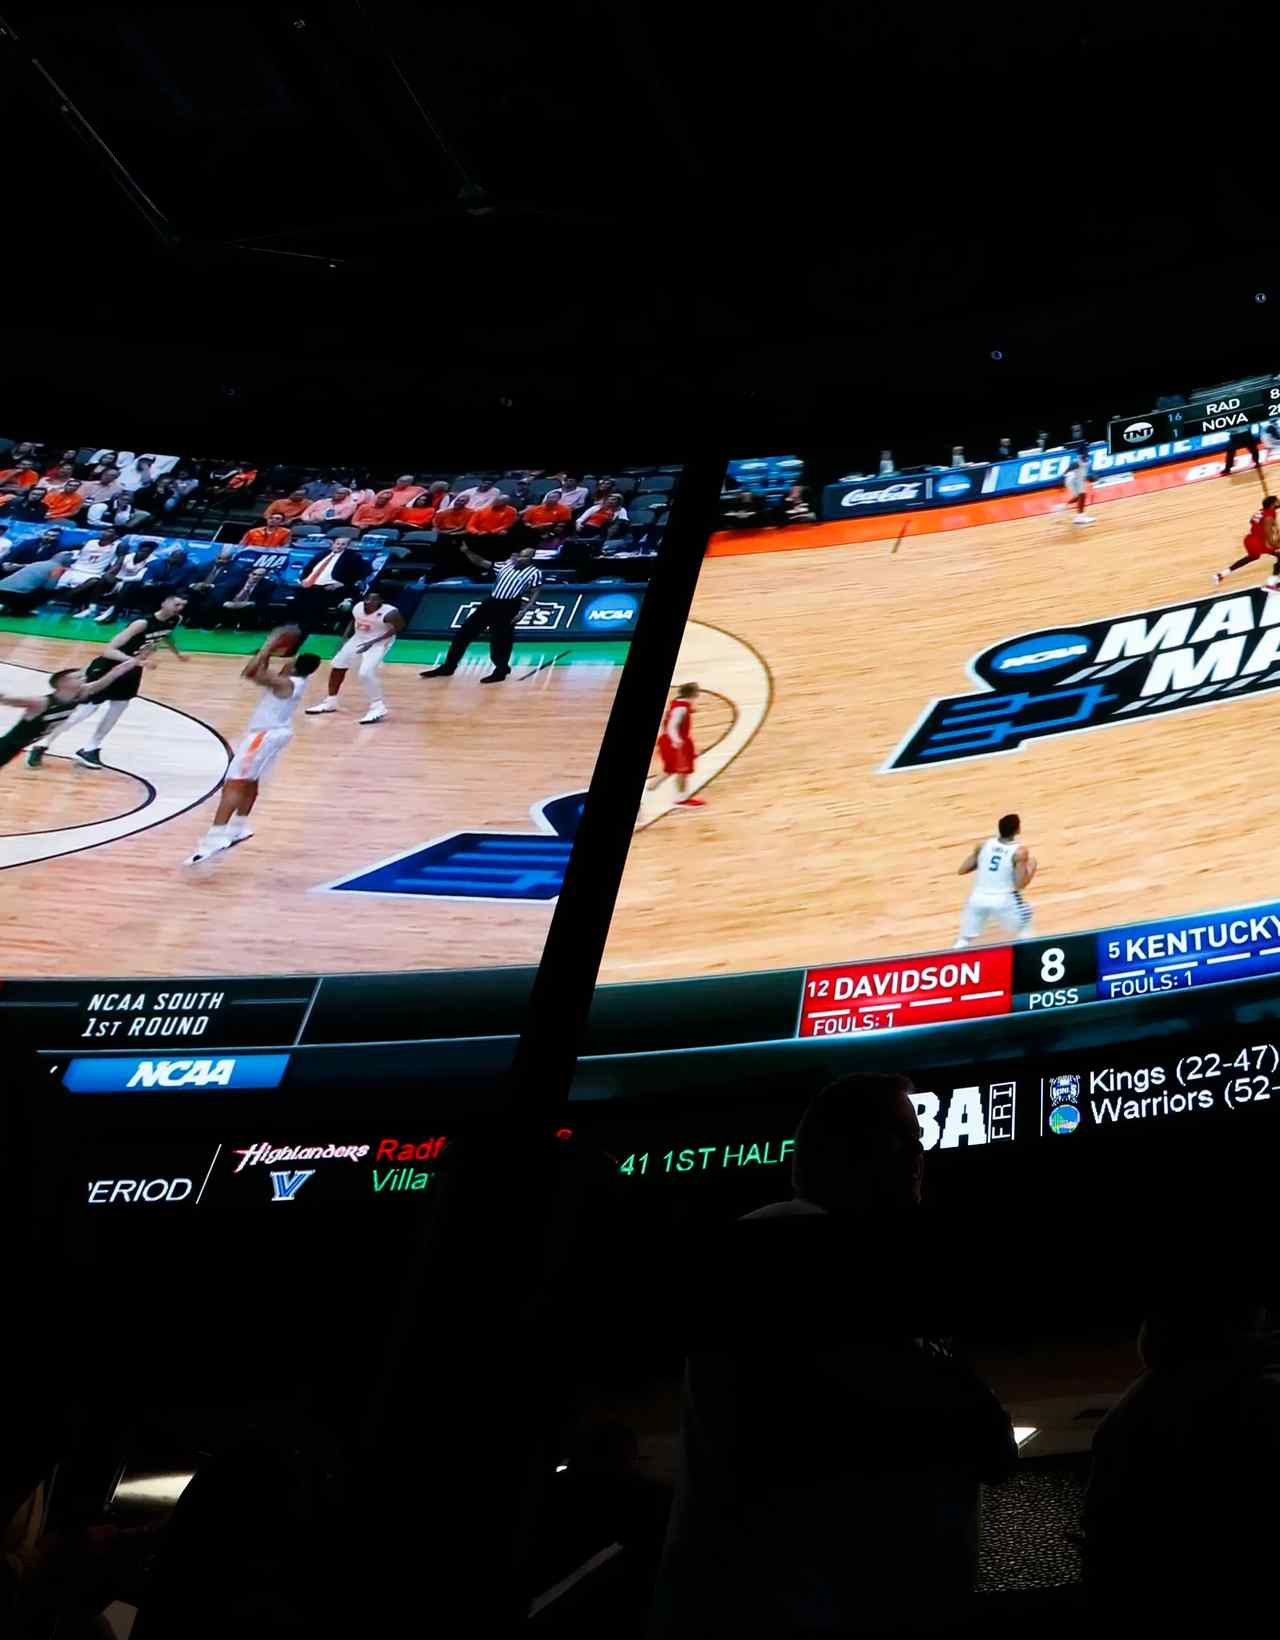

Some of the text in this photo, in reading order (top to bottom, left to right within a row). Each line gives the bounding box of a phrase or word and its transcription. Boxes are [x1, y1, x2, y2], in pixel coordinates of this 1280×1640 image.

[1168, 412, 1183, 423] 16
[1206, 397, 1241, 416] RAD
[1270, 388, 1280, 399] 8
[1123, 425, 1154, 443] TNT
[1202, 413, 1249, 433] NOVA
[588, 609, 634, 621] NCAA
[1108, 941, 1121, 960] 5
[1039, 946, 1066, 984] 8
[807, 960, 981, 1001] 12 DAVIDSON
[1109, 969, 1193, 999] FOULS: 1
[87, 991, 225, 1011] NCAA SOUTH
[1028, 987, 1079, 1011] POSS
[82, 1015, 209, 1038] 1ST ROUND
[812, 1012, 895, 1036] FOULS: 1
[126, 1058, 237, 1089] NCAA
[1089, 1066, 1167, 1095] Kings
[1176, 1044, 1280, 1087] (22-47)
[991, 1086, 1013, 1139] FRI
[1090, 1086, 1214, 1125] Warriors
[663, 1147, 716, 1173] 1ST
[722, 1139, 796, 1168] HALF
[87, 1177, 193, 1203] ERIOD
